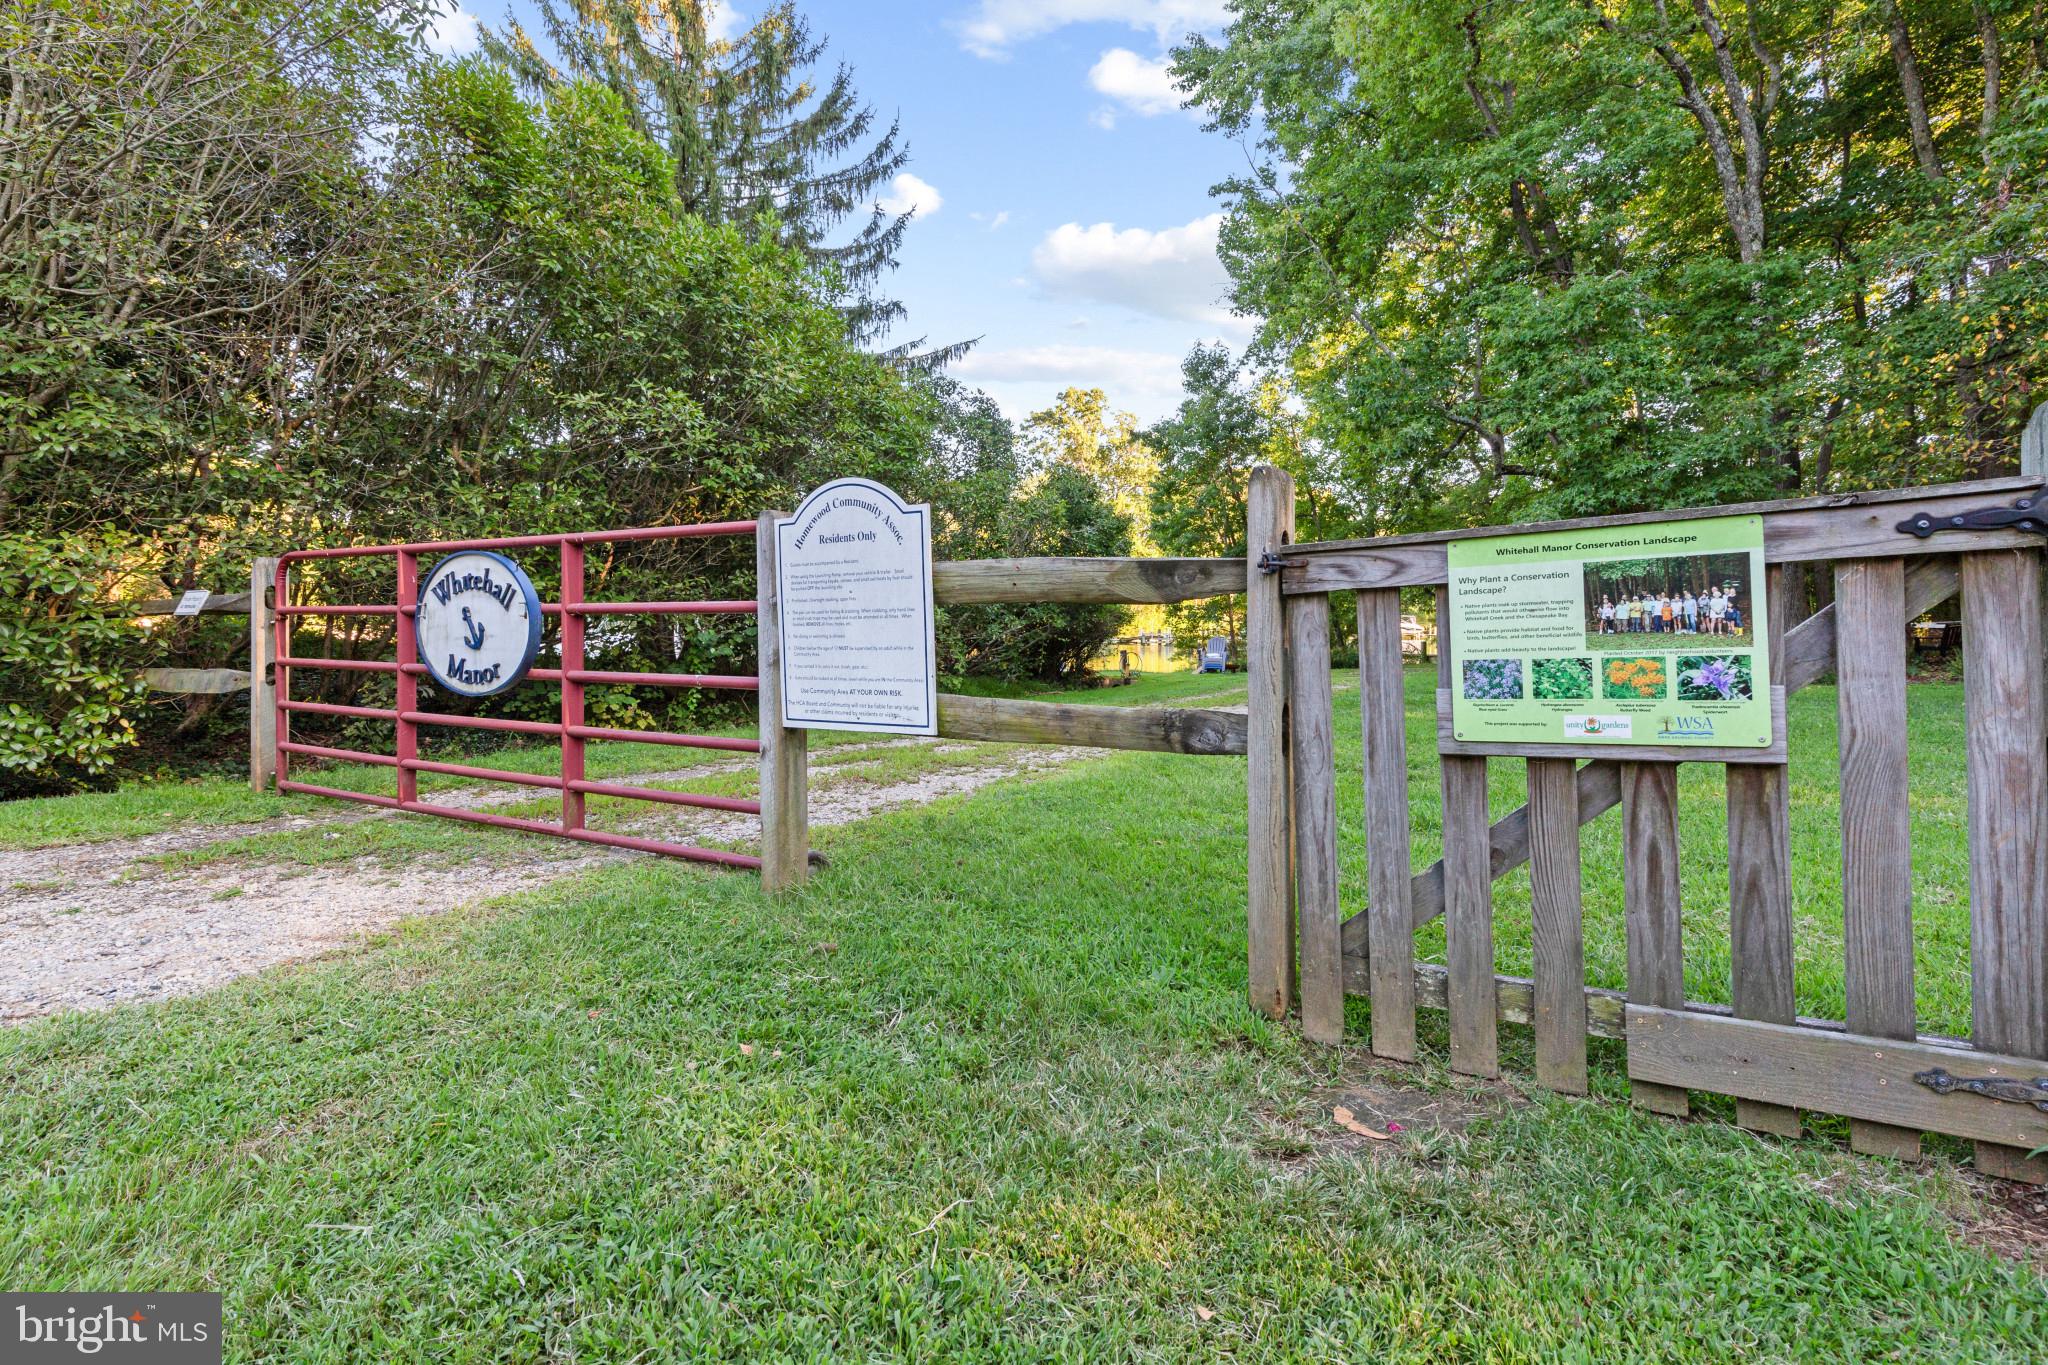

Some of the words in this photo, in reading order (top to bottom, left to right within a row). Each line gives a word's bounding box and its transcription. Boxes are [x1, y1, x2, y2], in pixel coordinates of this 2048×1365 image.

[795, 503, 831, 550] Homewood
[832, 497, 884, 519] Community
[882, 515, 904, 546] Assoc.
[819, 533, 855, 545] Residents
[857, 531, 877, 543] Only
[1496, 546, 1539, 556] Whitehall
[1542, 544, 1572, 553] Manor
[1575, 539, 1640, 551] Conservation
[1643, 534, 1698, 546] Landscape
[1459, 577, 1477, 585] Why
[1480, 575, 1501, 583] Plant
[1511, 571, 1570, 582] Conservation
[431, 568, 517, 612] Whitehall
[1459, 586, 1507, 596] Landscape?
[447, 654, 501, 686] Manor
[810, 688, 836, 696] Community
[827, 701, 850, 709] Community
[1602, 721, 1629, 730] gardens
[1677, 717, 1714, 730] WSA
